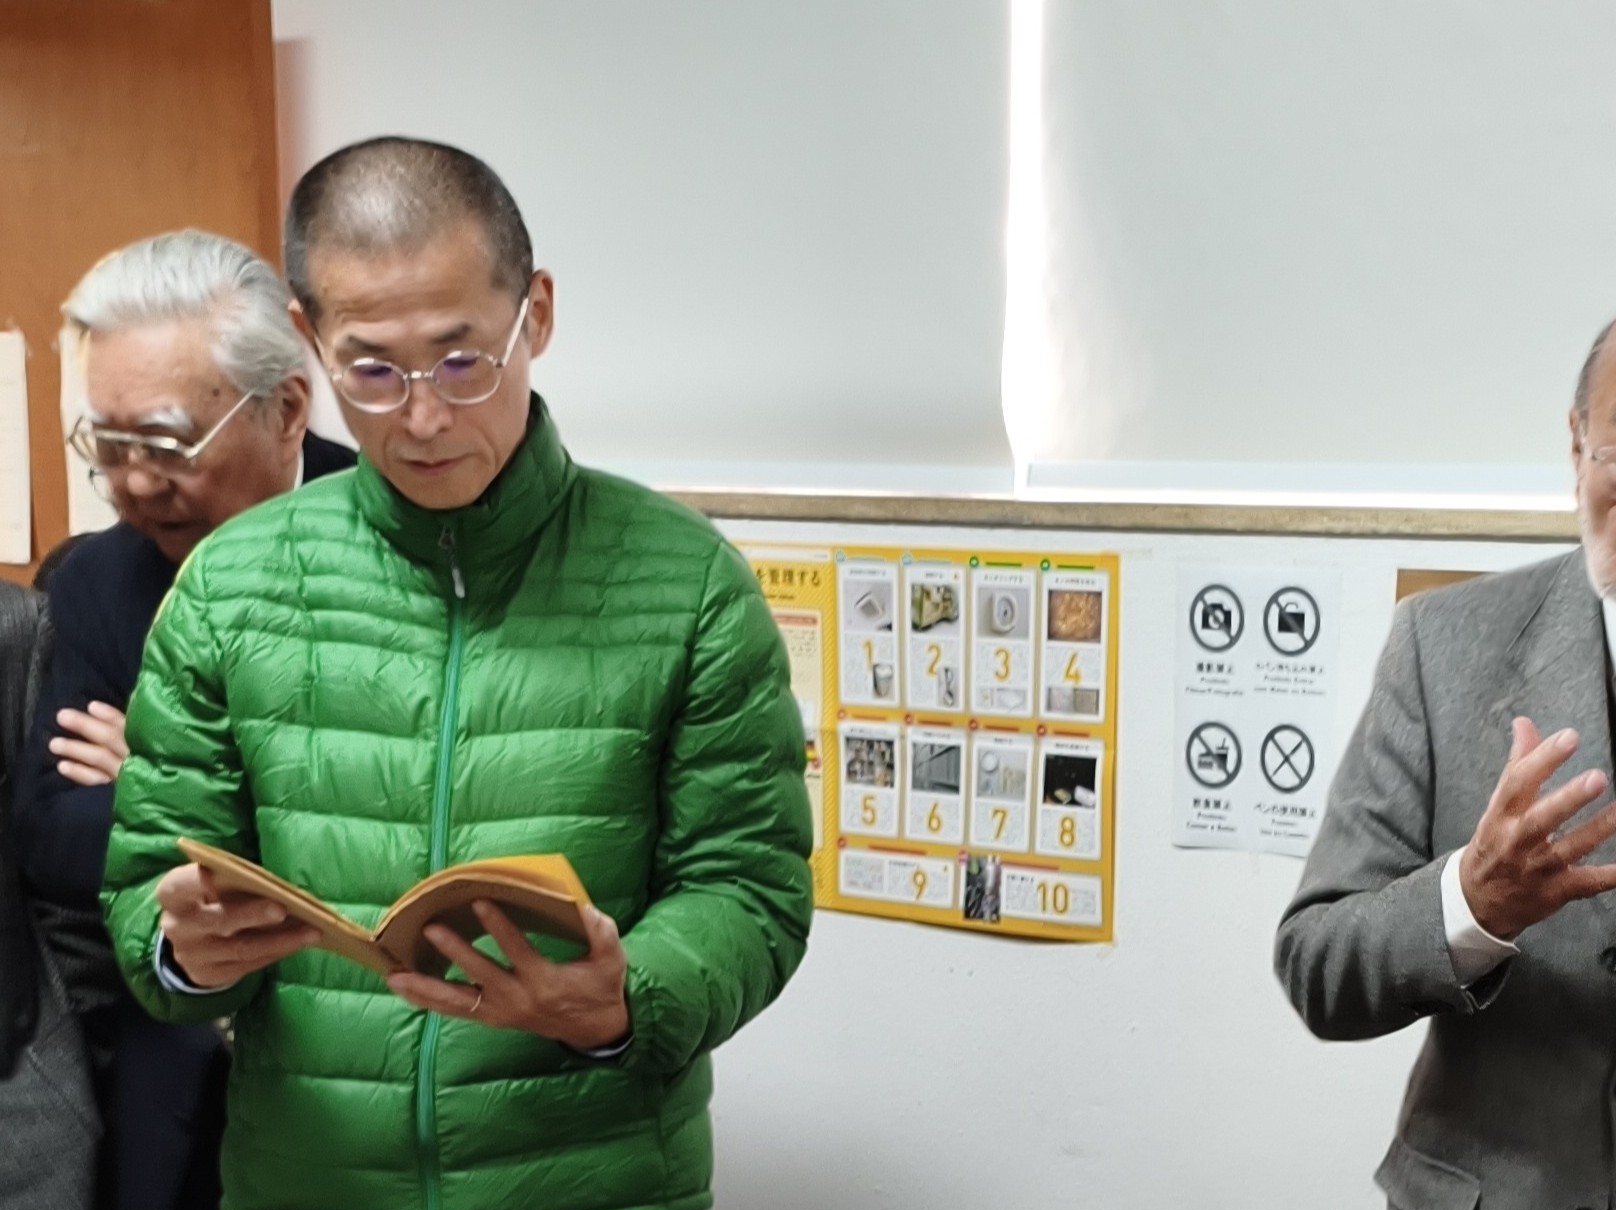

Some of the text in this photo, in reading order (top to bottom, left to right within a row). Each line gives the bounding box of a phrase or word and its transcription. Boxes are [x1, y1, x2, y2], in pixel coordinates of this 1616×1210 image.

[864, 639, 875, 671] 1
[927, 643, 942, 678] 2
[994, 648, 1010, 682] 3
[1065, 653, 1082, 684] 4
[862, 796, 877, 826] 5
[928, 803, 942, 834] 6
[992, 809, 1008, 841] 7
[1060, 817, 1075, 848] 8
[912, 871, 928, 901] 9
[1037, 881, 1069, 915] 10
